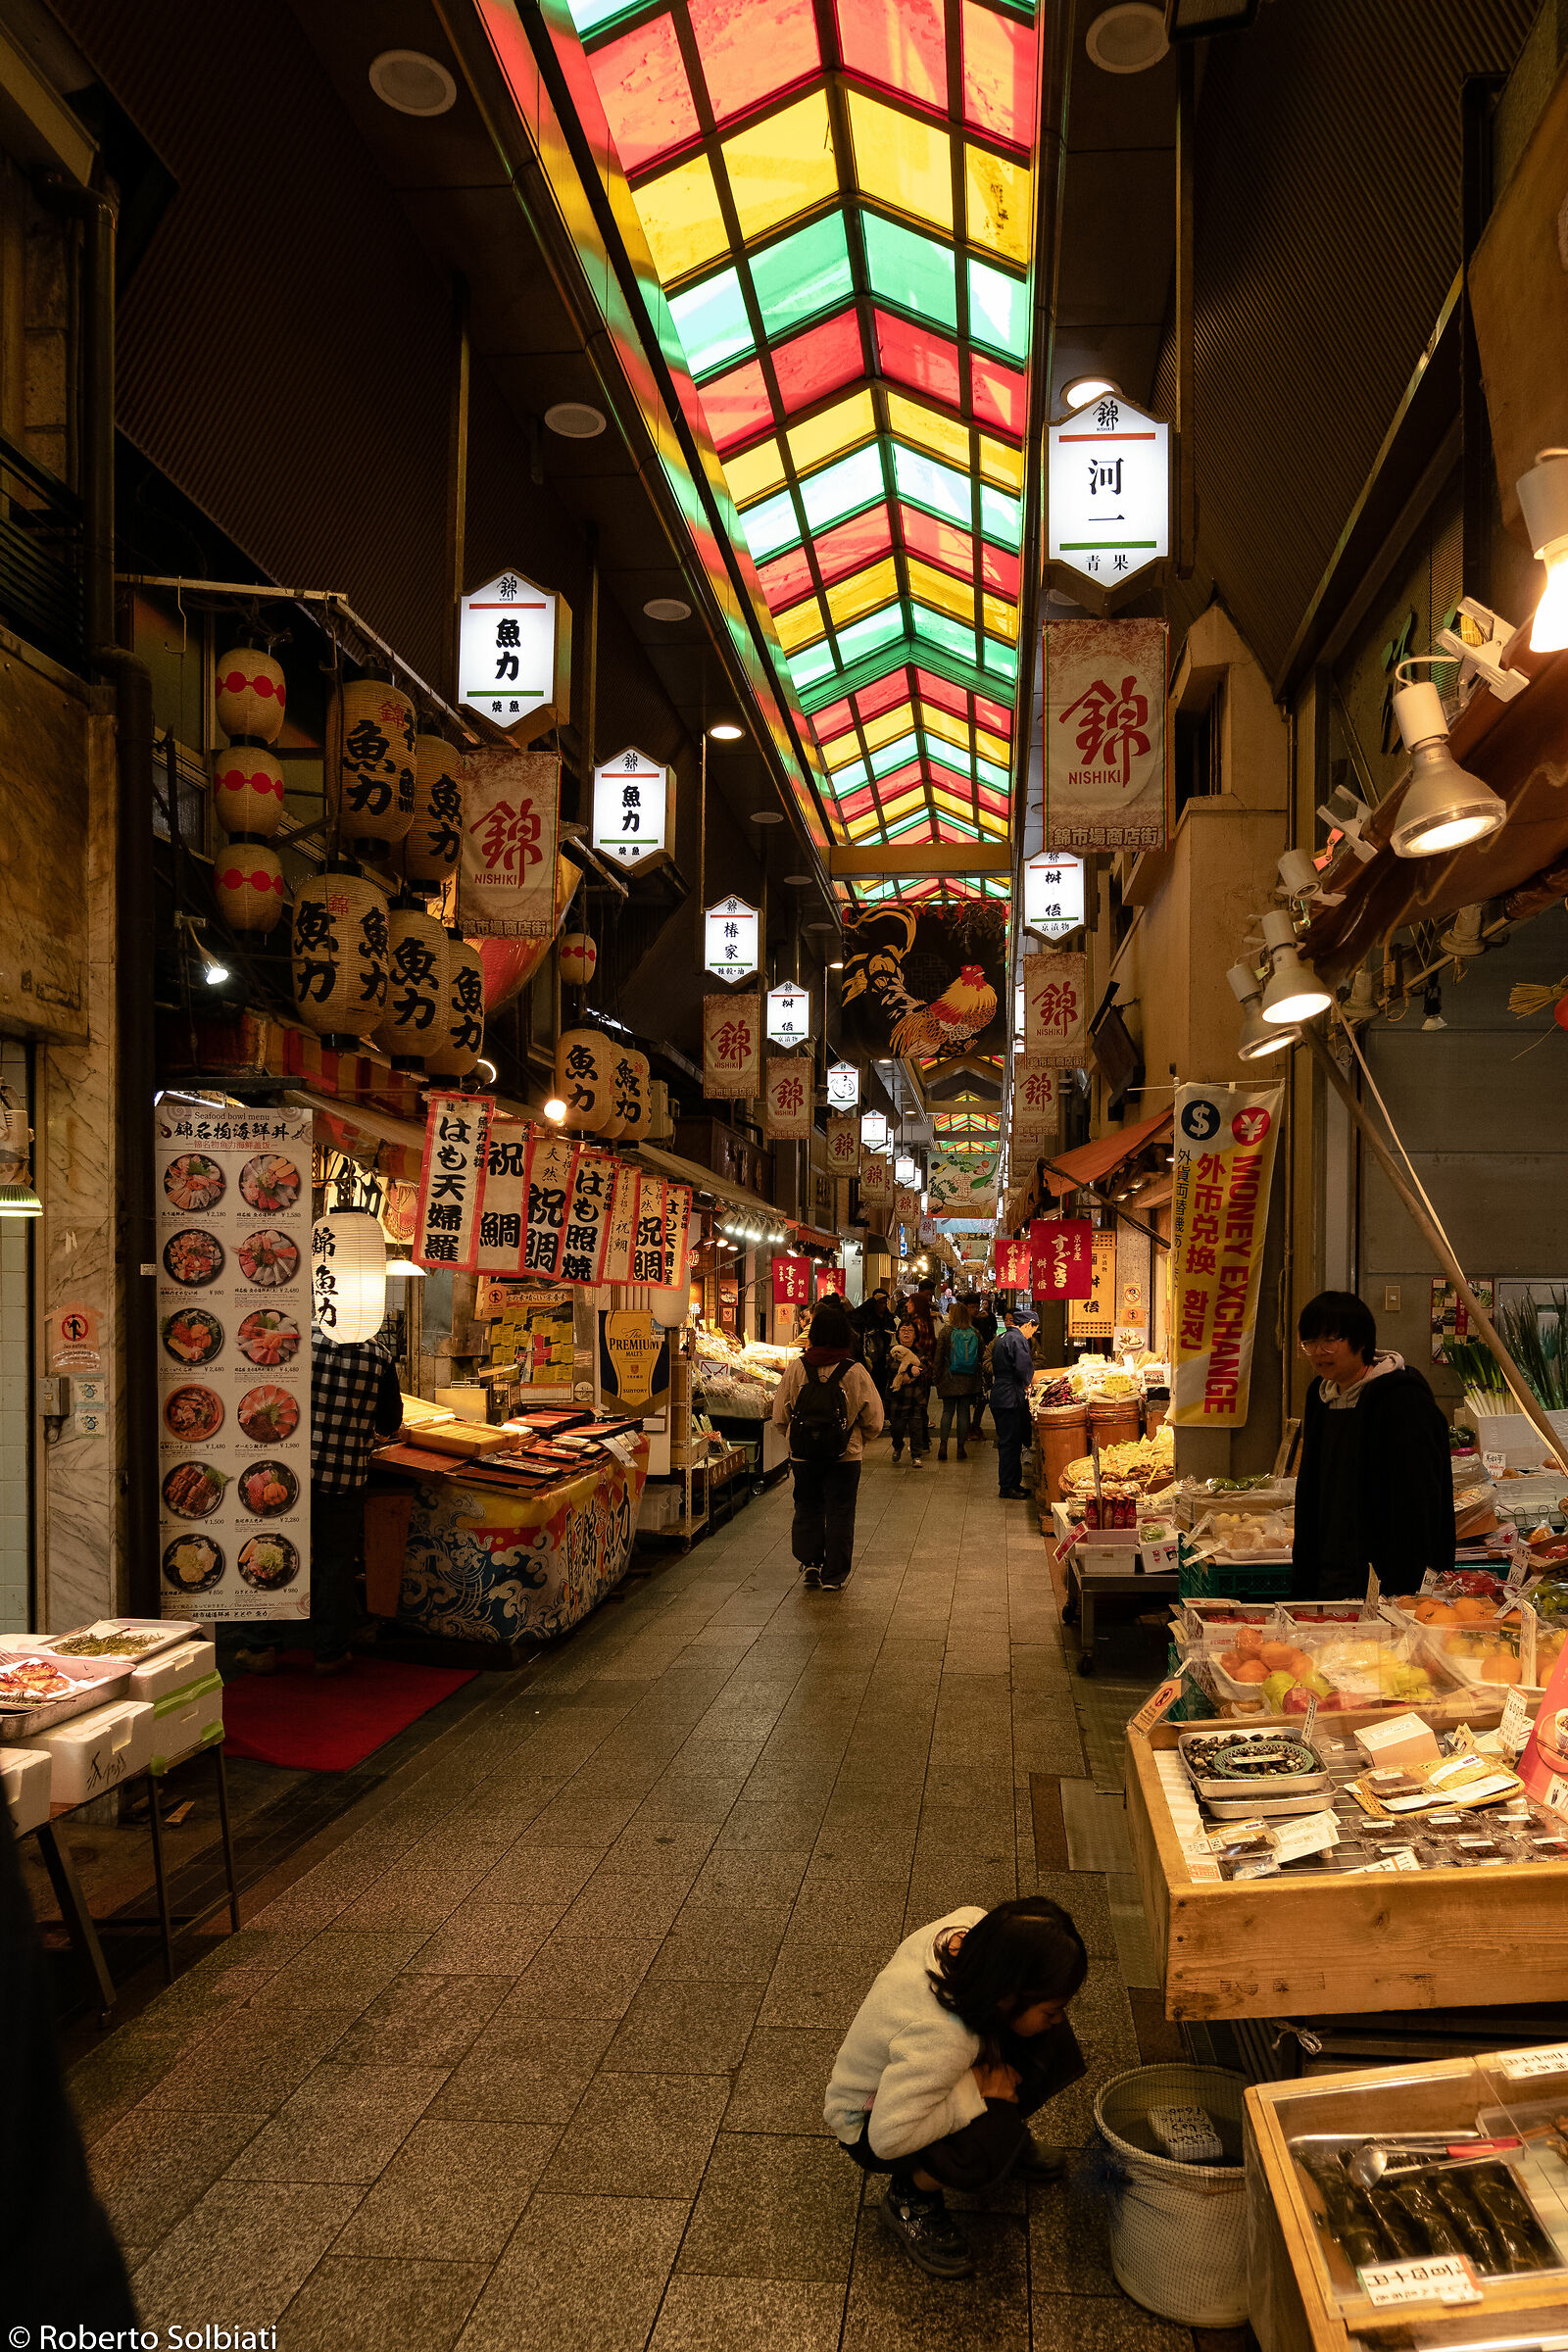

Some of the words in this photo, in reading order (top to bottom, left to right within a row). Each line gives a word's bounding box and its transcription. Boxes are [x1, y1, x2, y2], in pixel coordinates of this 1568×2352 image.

[1093, 400, 1119, 431] 錦
[1088, 458, 1125, 521] 河一
[496, 576, 517, 601] 錦
[1085, 554, 1129, 571] 青果
[495, 618, 521, 681] 魚力
[492, 700, 520, 713] 焼魚
[1058, 675, 1151, 788] 錦
[343, 719, 396, 816] 魚力
[621, 753, 638, 772] 錦
[1068, 769, 1121, 785] NISHIKI
[427, 773, 464, 863] 魚力
[621, 785, 641, 833] 魚力
[469, 798, 543, 889] 錦
[618, 846, 640, 856] 焼魚
[1054, 826, 1158, 847] 錦市場商店街
[474, 873, 517, 887] NISHIKI
[295, 901, 339, 1004] 魚力
[463, 919, 547, 936] 錦市場商店街
[723, 921, 739, 960] 椿家
[392, 937, 439, 1029] 魚力
[449, 966, 484, 1053] 魚力
[1032, 981, 1078, 1038] 錦
[710, 1019, 753, 1070] 錦
[565, 1044, 599, 1112] 魚力
[771, 1077, 805, 1116] 錦
[1019, 1072, 1053, 1112] 錦
[830, 1133, 854, 1161] 錦
[424, 1116, 471, 1262] はも天婦羅
[480, 1141, 524, 1249] 祝鯛
[1185, 1152, 1226, 1276] 外币兑换
[1222, 1154, 1263, 1259] MONEY
[561, 1169, 605, 1282] はも照焼
[1073, 1234, 1082, 1261] 京名産
[313, 1227, 338, 1328] 錦魚力
[1051, 1234, 1071, 1288] すぐき
[610, 1338, 660, 1350] PREMIUM
[621, 1328, 647, 1339] The
[1180, 1289, 1209, 1350] 환전
[1203, 1265, 1250, 1414] EXCHANGE
